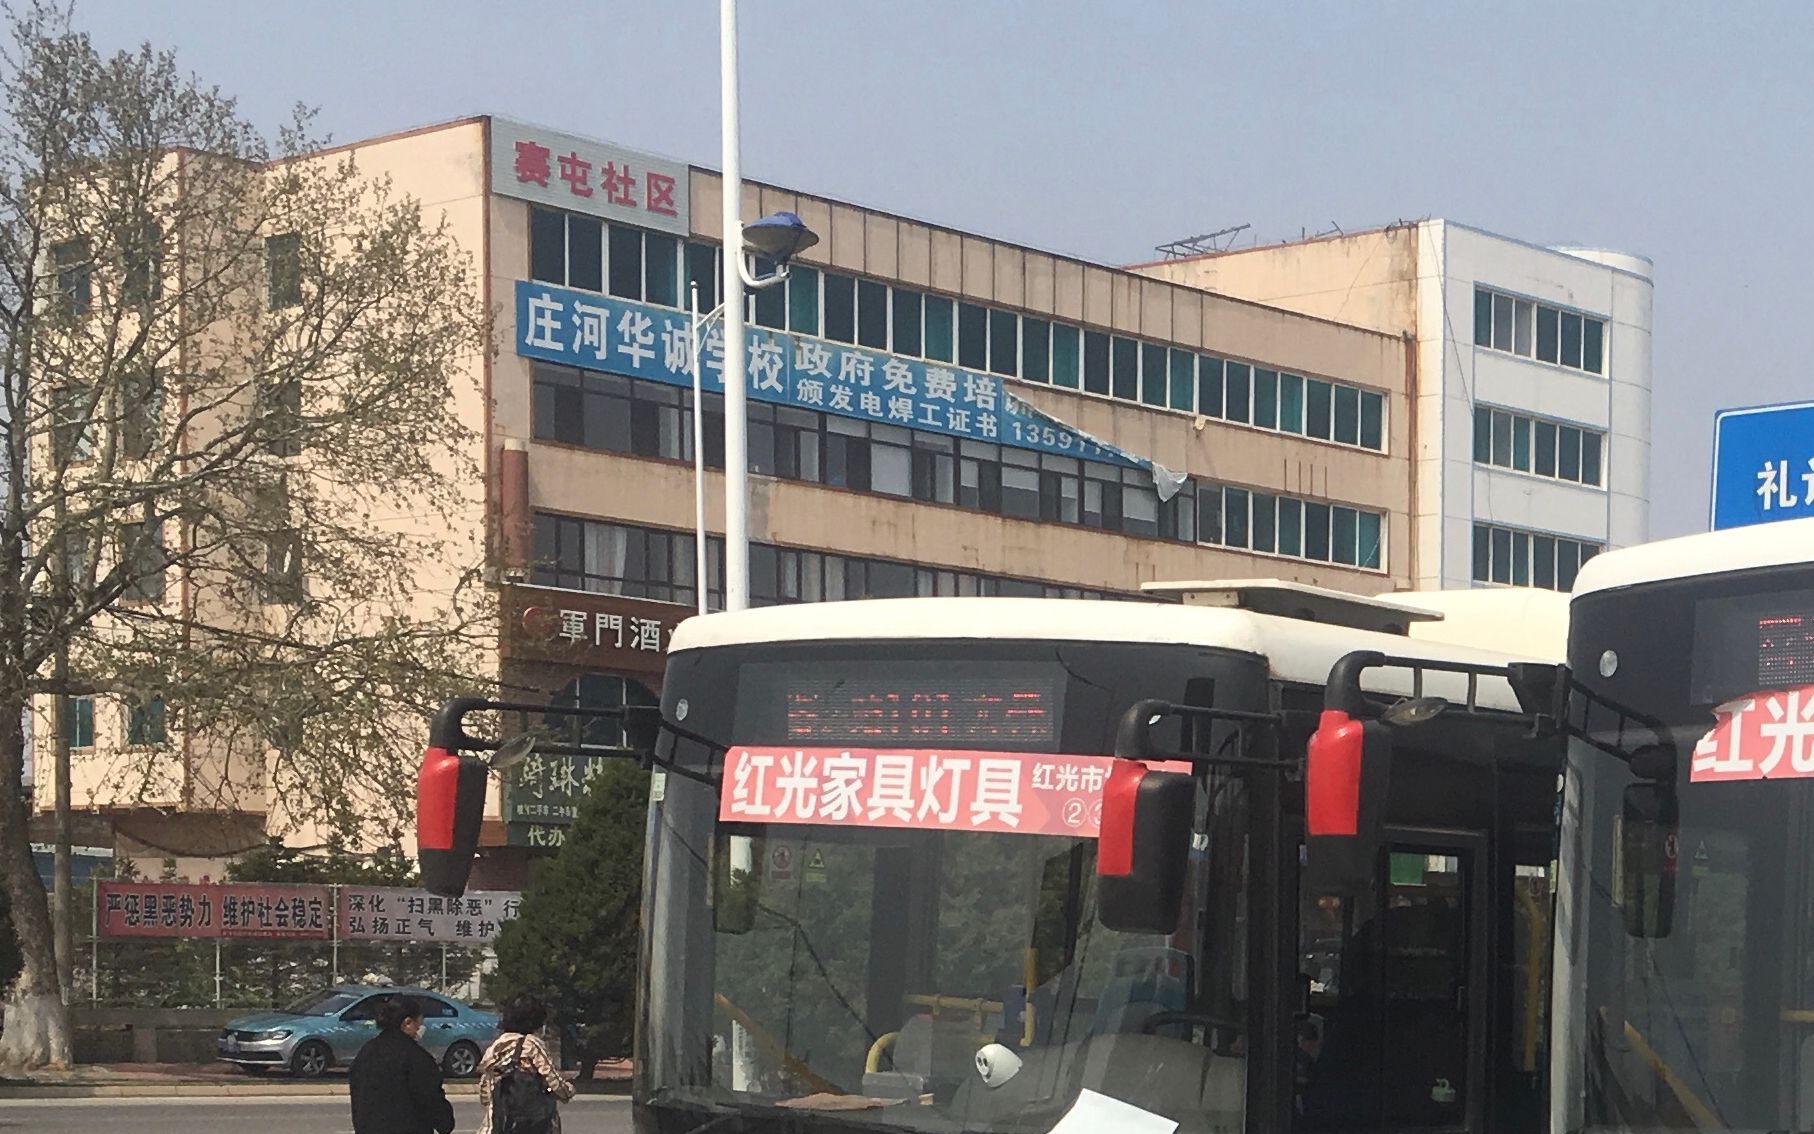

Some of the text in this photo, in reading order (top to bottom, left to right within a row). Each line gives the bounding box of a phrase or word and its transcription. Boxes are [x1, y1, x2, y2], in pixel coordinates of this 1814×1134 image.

[514, 141, 679, 219] 赛屯社区
[797, 377, 998, 438] 颁发电焊工证书
[559, 609, 676, 652] 軍門酒
[730, 751, 1023, 828] 红光家具灯具
[1031, 762, 1112, 793] 红光市
[105, 892, 324, 930] 严惩黑恶势力 维护社会稳定
[348, 894, 386, 913] 深化
[349, 916, 435, 937] 弘扬正气
